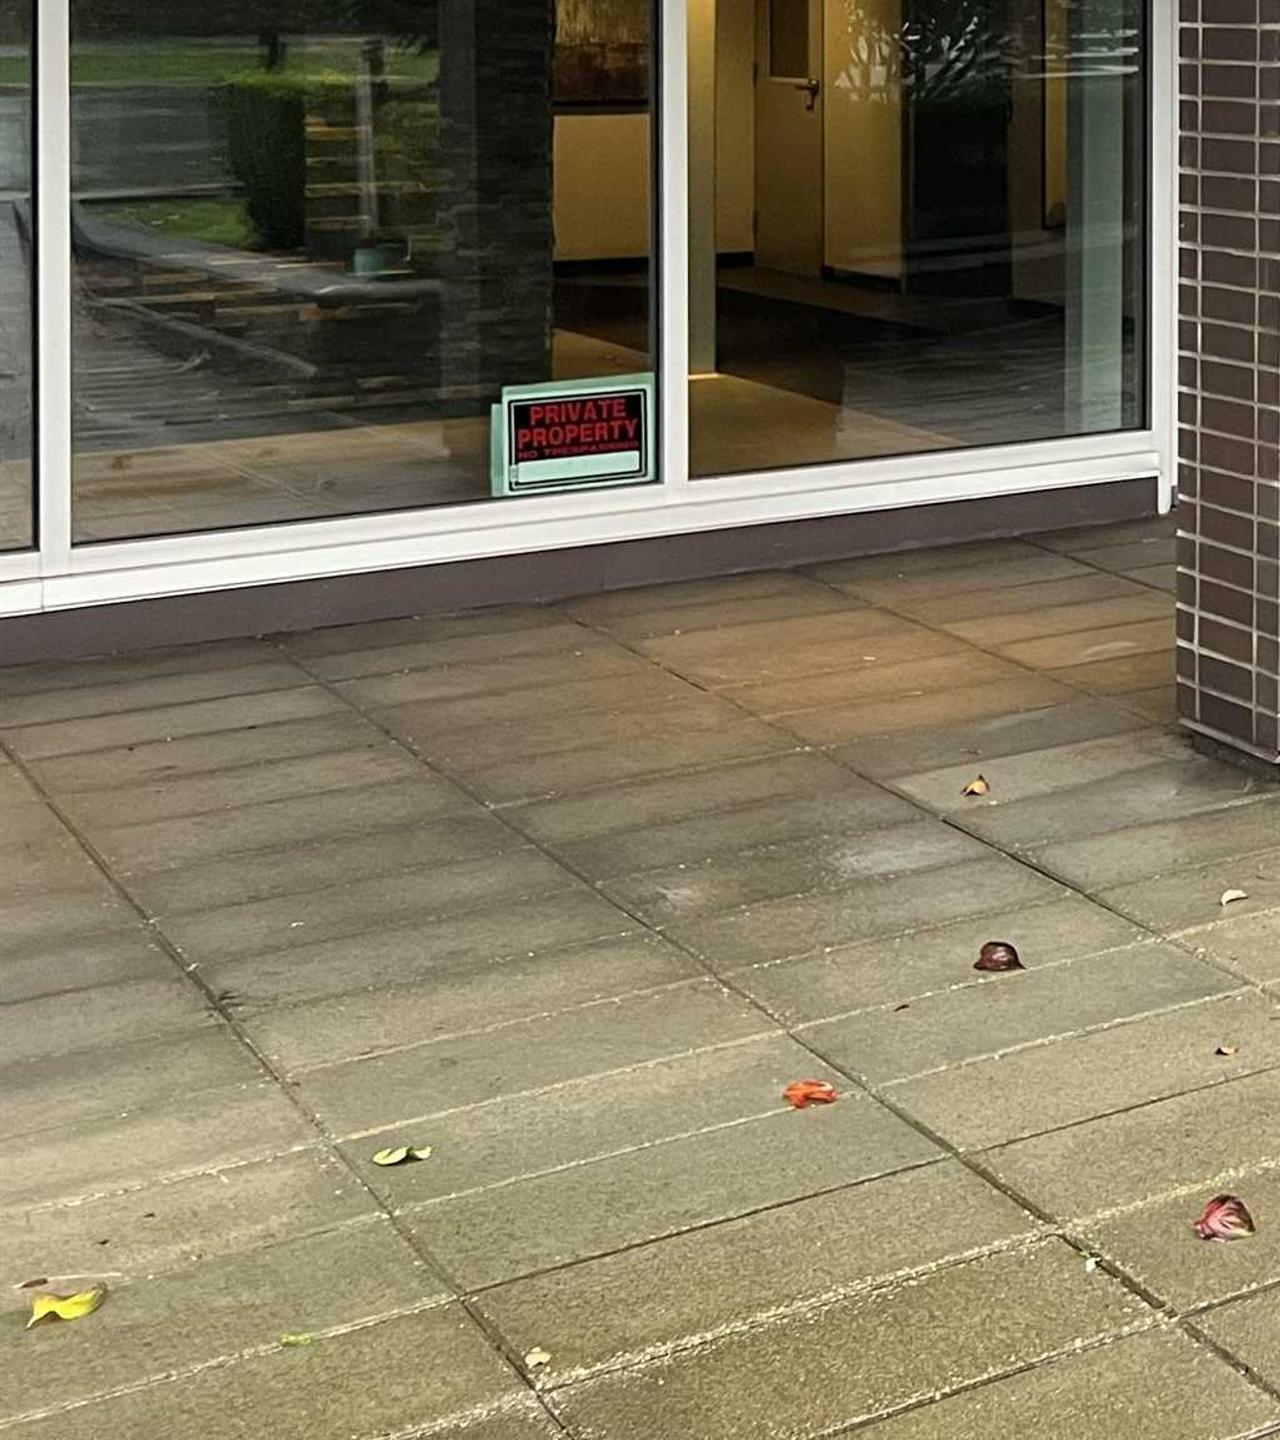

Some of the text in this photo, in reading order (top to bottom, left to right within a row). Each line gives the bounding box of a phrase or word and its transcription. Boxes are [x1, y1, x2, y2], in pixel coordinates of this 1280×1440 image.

[530, 398, 627, 426] PRIVATE
[517, 418, 638, 449] PROPERTY
[518, 449, 539, 459] NO
